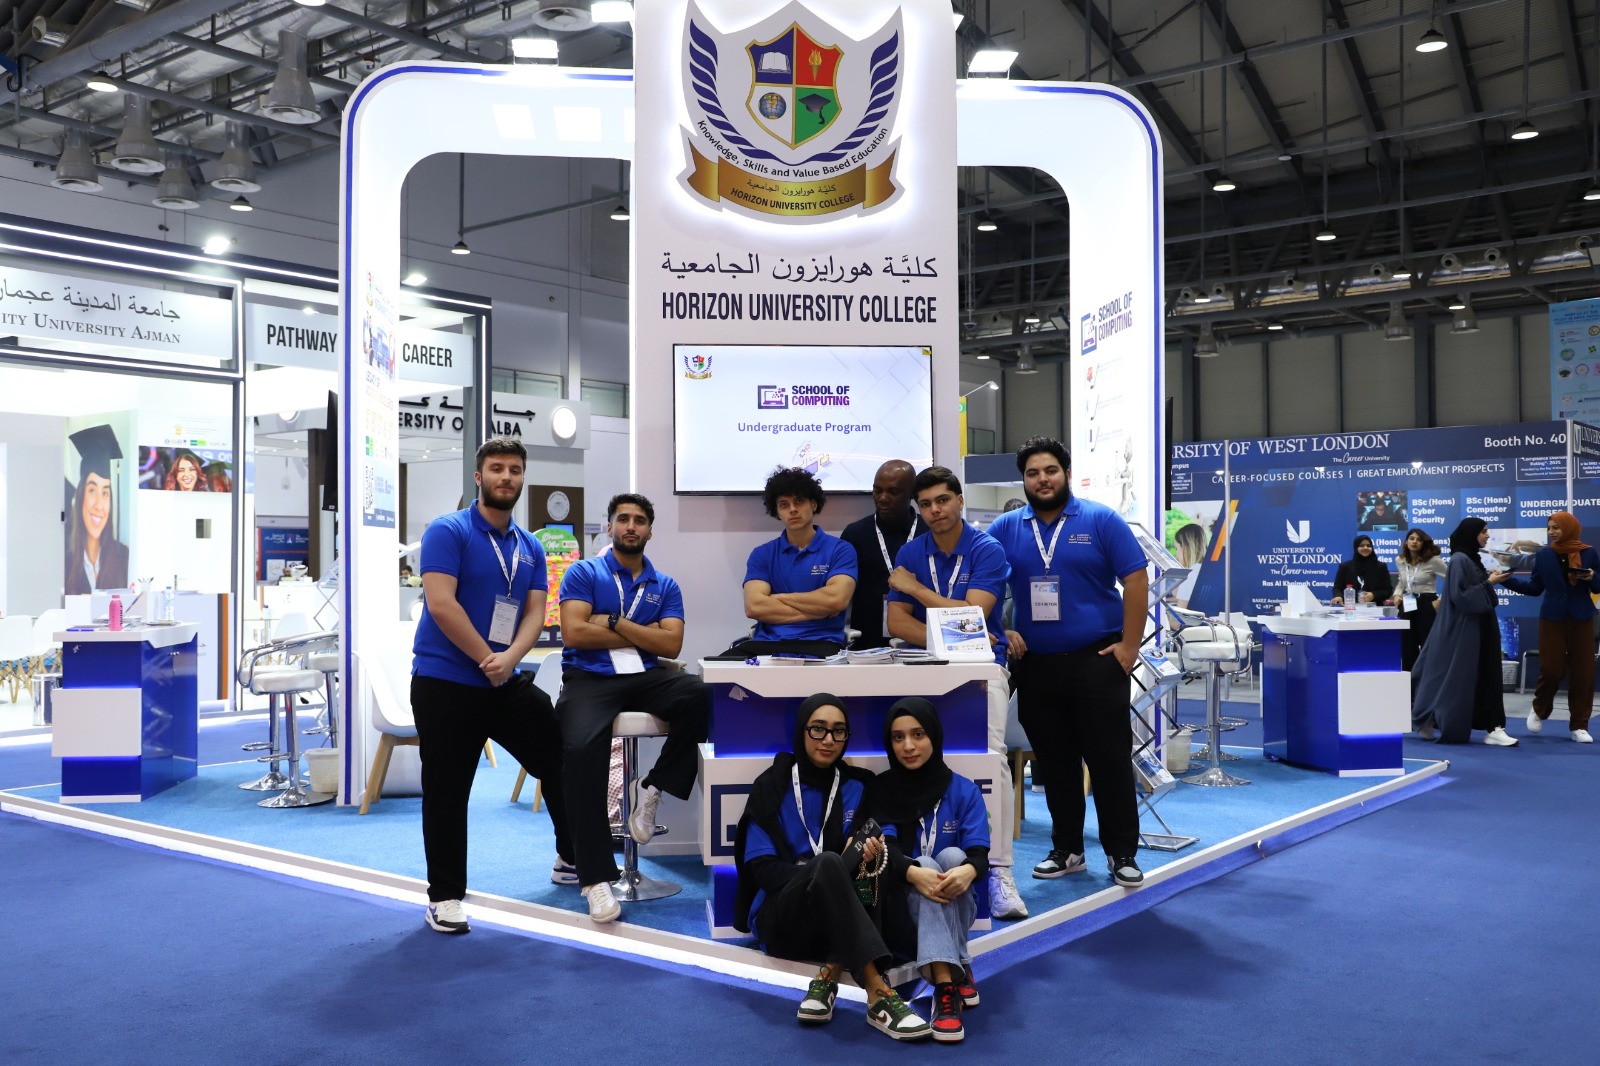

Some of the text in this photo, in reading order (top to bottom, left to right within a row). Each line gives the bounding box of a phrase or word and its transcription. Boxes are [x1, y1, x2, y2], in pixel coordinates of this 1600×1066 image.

[697, 119, 888, 178] Knowledge, Skills and Value Based Education
[730, 187, 855, 211] HORIZON UNIVERSITY COLLEGE
[661, 252, 760, 280] الجامعية
[772, 255, 873, 283] هورايزون
[63, 285, 121, 313] المدينة
[128, 295, 181, 323] جامعة
[662, 292, 937, 323] HORIZON UNIVERSITY COLLEGE
[1098, 291, 1133, 322] SCHOOL OF
[1, 312, 27, 326] ITY
[1098, 310, 1133, 341] COMPUTING
[267, 323, 338, 353] PATHWAY
[402, 342, 453, 368] CAREER
[791, 385, 850, 395] SCHOOL OF
[791, 395, 850, 406] COMPUTING
[399, 411, 445, 431] ERSITY
[452, 416, 464, 431] O
[737, 422, 872, 435] Undergraduate Program
[1171, 433, 1390, 459] RSITY OF WEST LONDON
[1484, 435, 1521, 448] Booth
[1525, 435, 1547, 446] No.
[1342, 452, 1364, 464] Career
[1212, 463, 1505, 485] CAEER-FOCUSED COURSES GREAT EMPLOYMENT PROSPECTS
[1412, 497, 1456, 507] BSc (Hons)
[1483, 496, 1512, 505] (Hons)
[1412, 507, 1436, 516] Cyber
[1466, 506, 1507, 514] Computer
[1412, 516, 1445, 525] Security
[1433, 537, 1451, 545] ons)
[1257, 553, 1343, 564] WEST LONDON
[1281, 565, 1302, 576] Career
[1312, 580, 1334, 588] Campu
